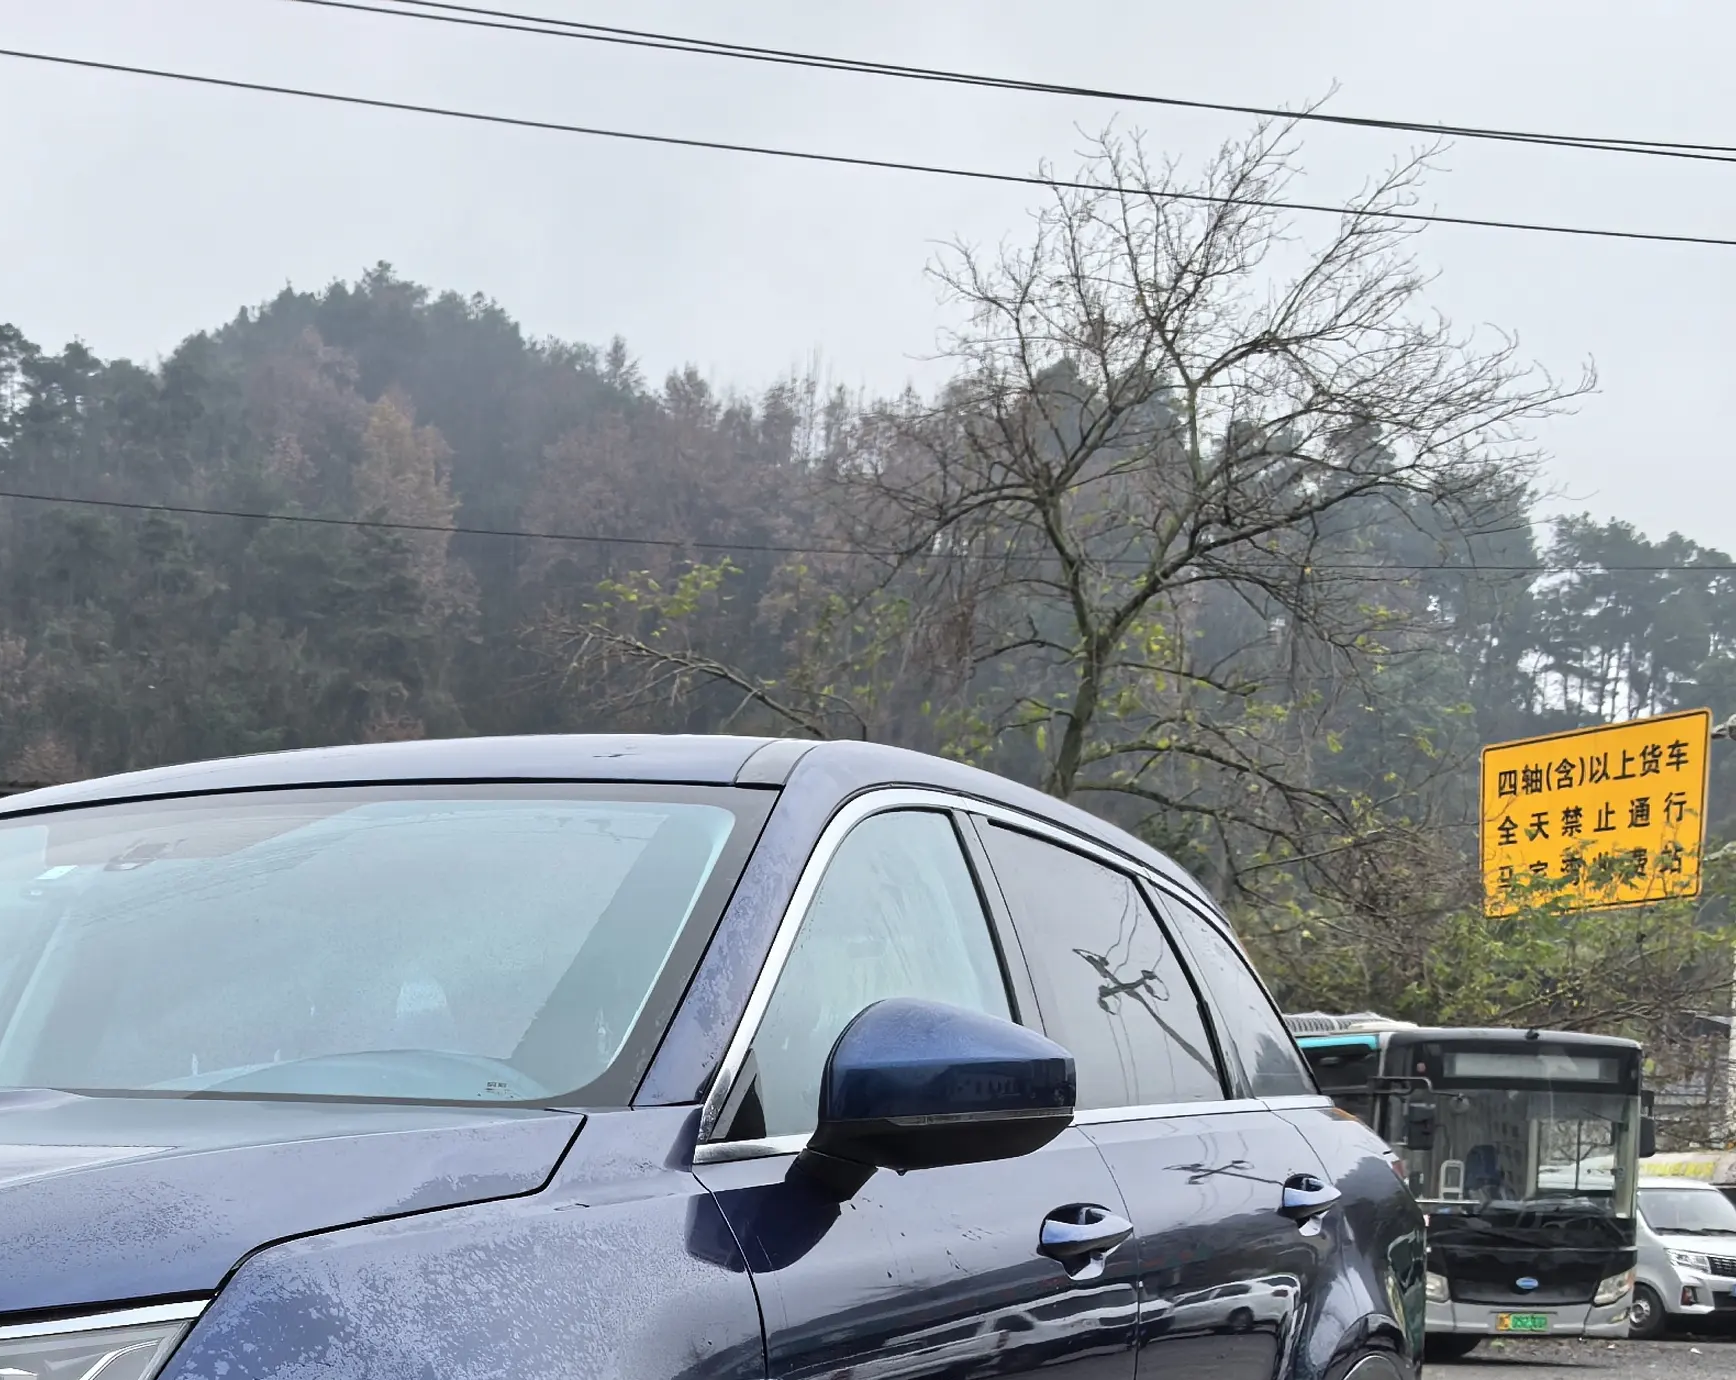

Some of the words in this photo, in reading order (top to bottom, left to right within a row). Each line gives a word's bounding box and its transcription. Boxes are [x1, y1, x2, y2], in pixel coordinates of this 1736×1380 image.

[1497, 739, 1690, 799] 四轴(含)以上货车
[1496, 791, 1688, 846] 全天禁止通行
